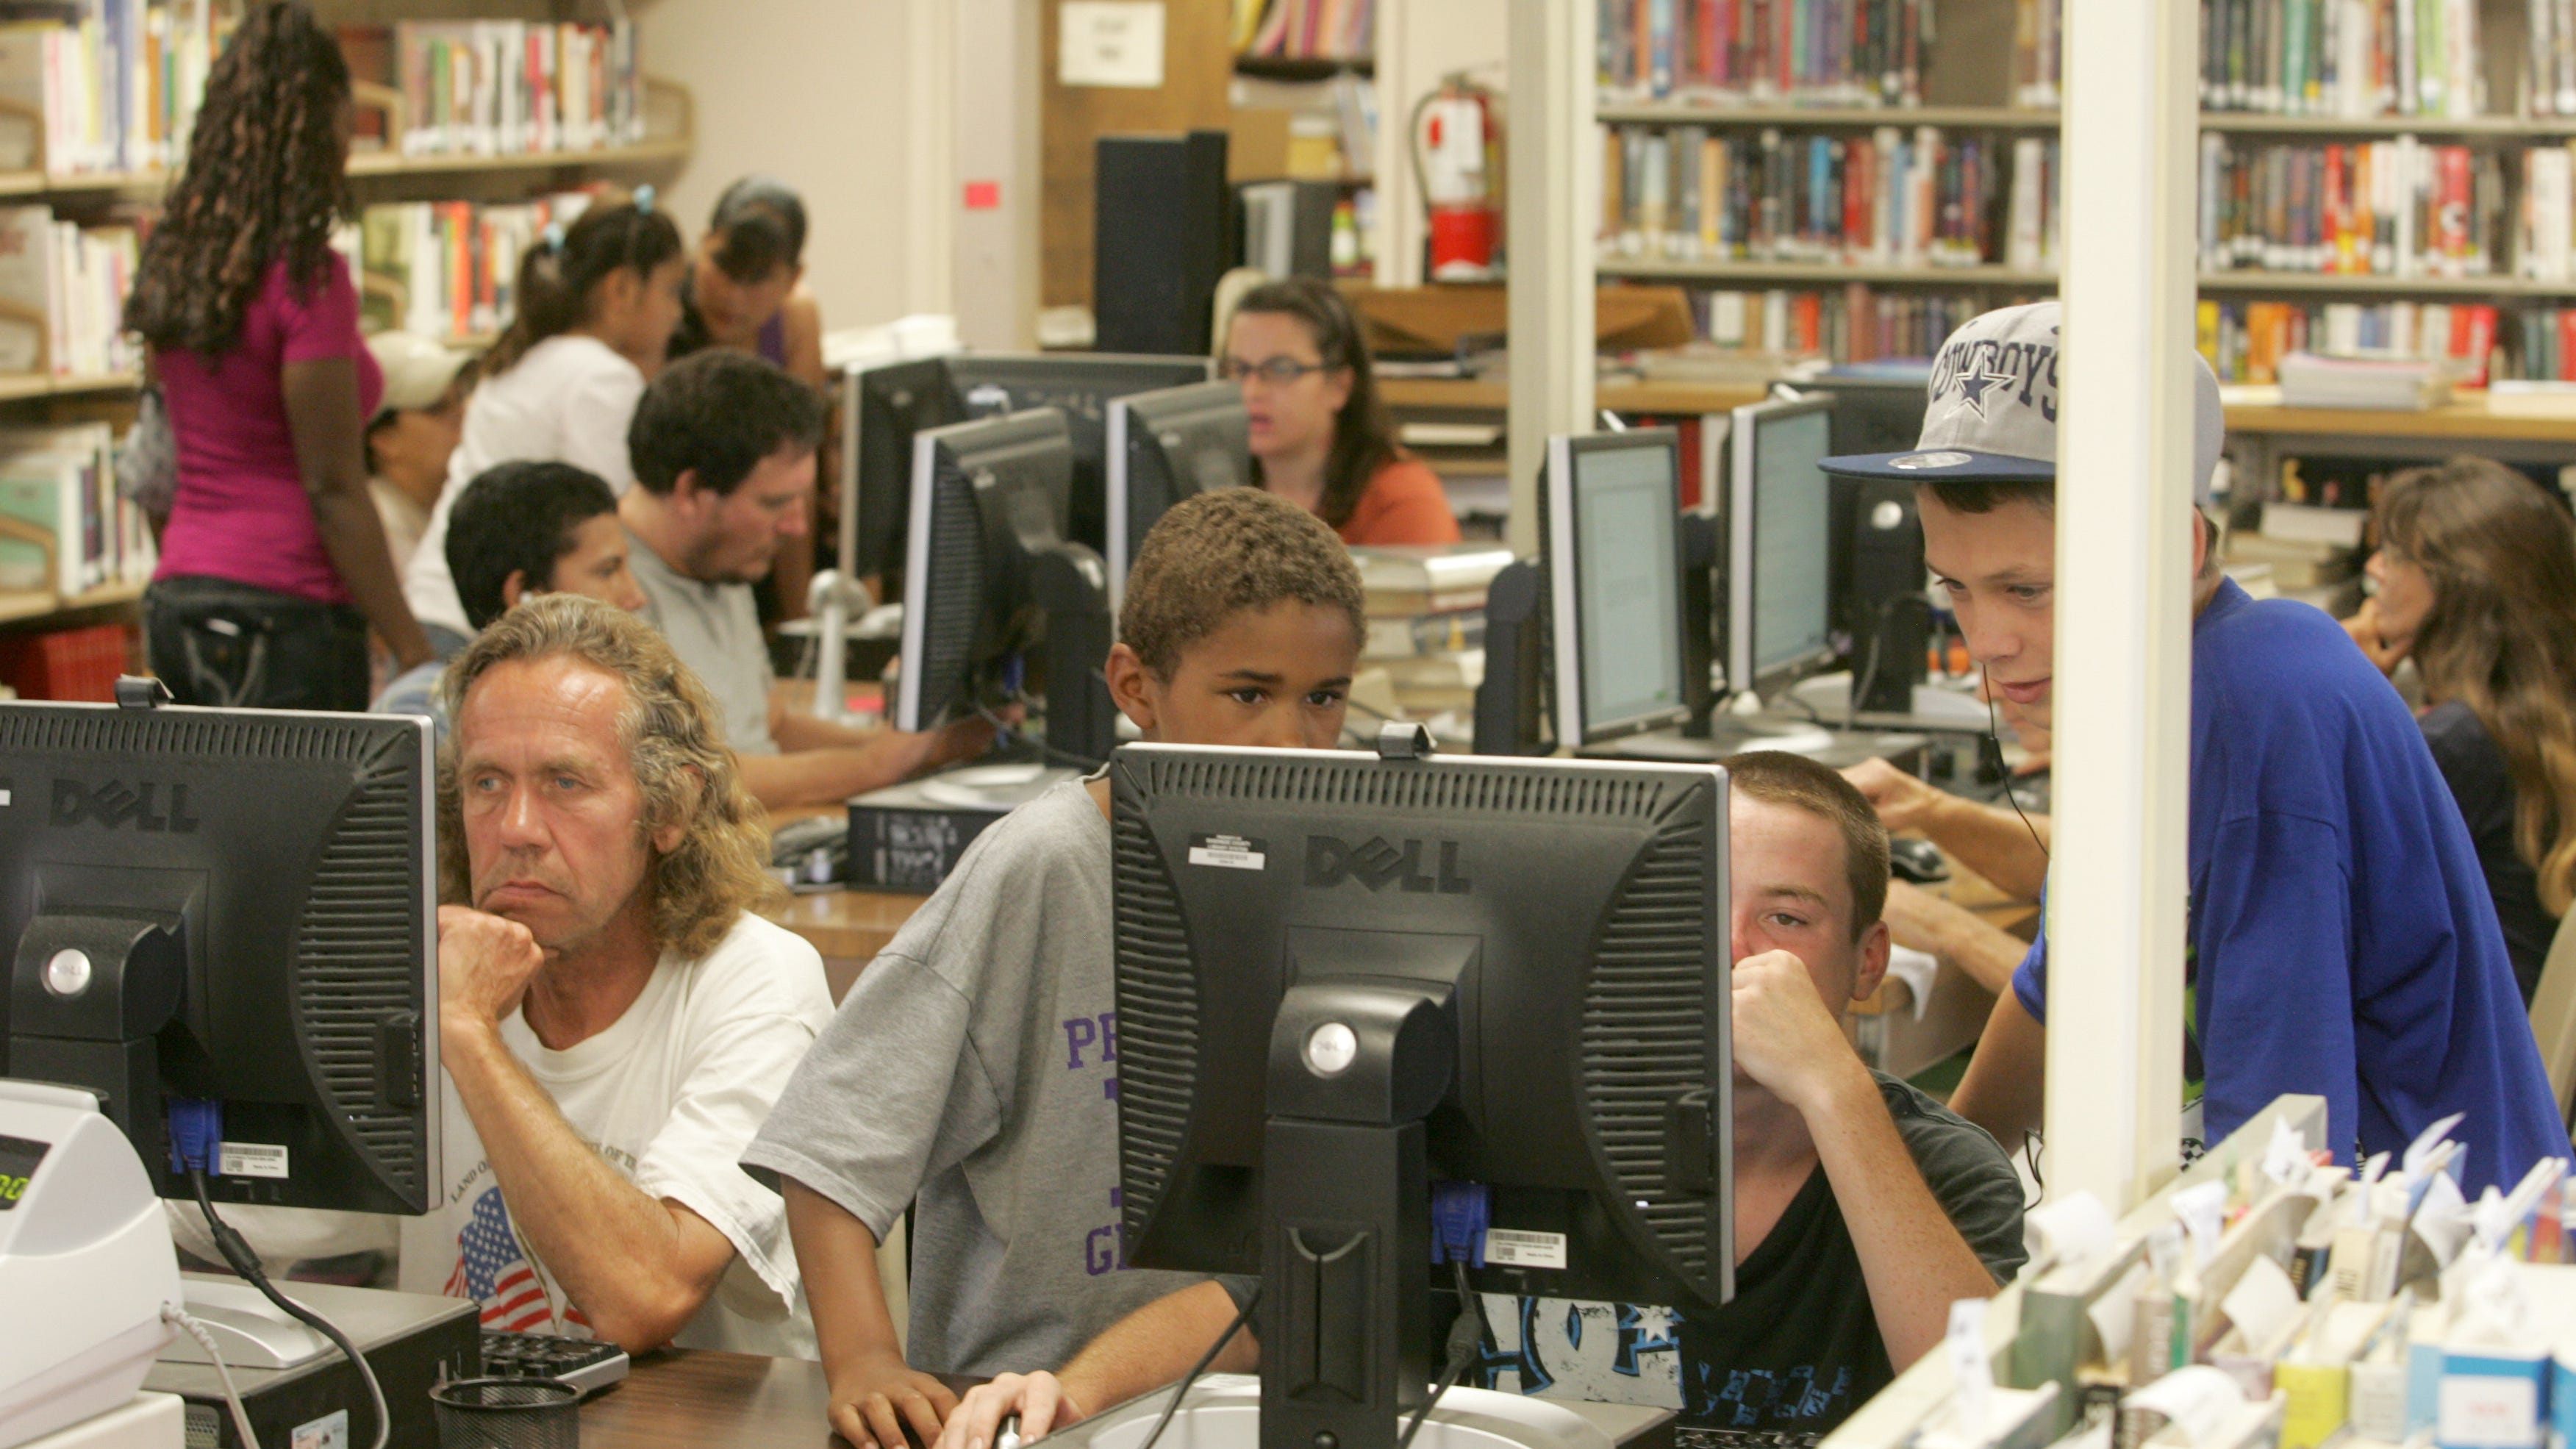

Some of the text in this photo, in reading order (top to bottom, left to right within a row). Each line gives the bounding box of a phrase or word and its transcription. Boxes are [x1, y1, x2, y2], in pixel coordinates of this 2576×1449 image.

[49, 779, 200, 833] DELL
[1304, 835, 1470, 894] DELL
[449, 1168, 478, 1205] LAND
